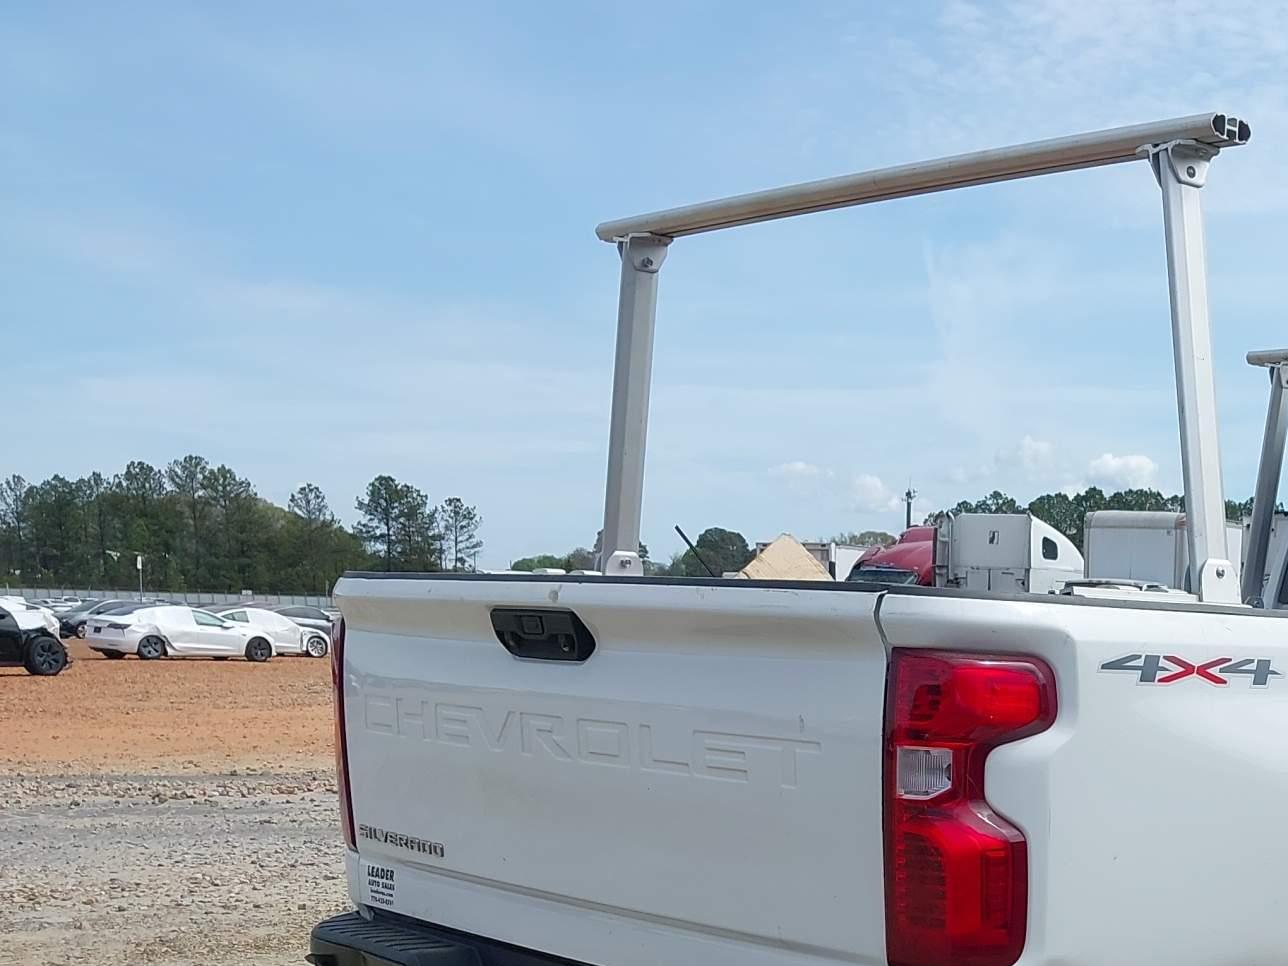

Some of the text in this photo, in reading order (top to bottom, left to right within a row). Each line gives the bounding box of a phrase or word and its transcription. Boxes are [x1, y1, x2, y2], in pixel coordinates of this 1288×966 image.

[364, 692, 822, 790] CHEVROLET
[358, 823, 445, 858] SILVERADO
[367, 864, 395, 882] LEADER
[368, 878, 395, 891] AUTO SALES
